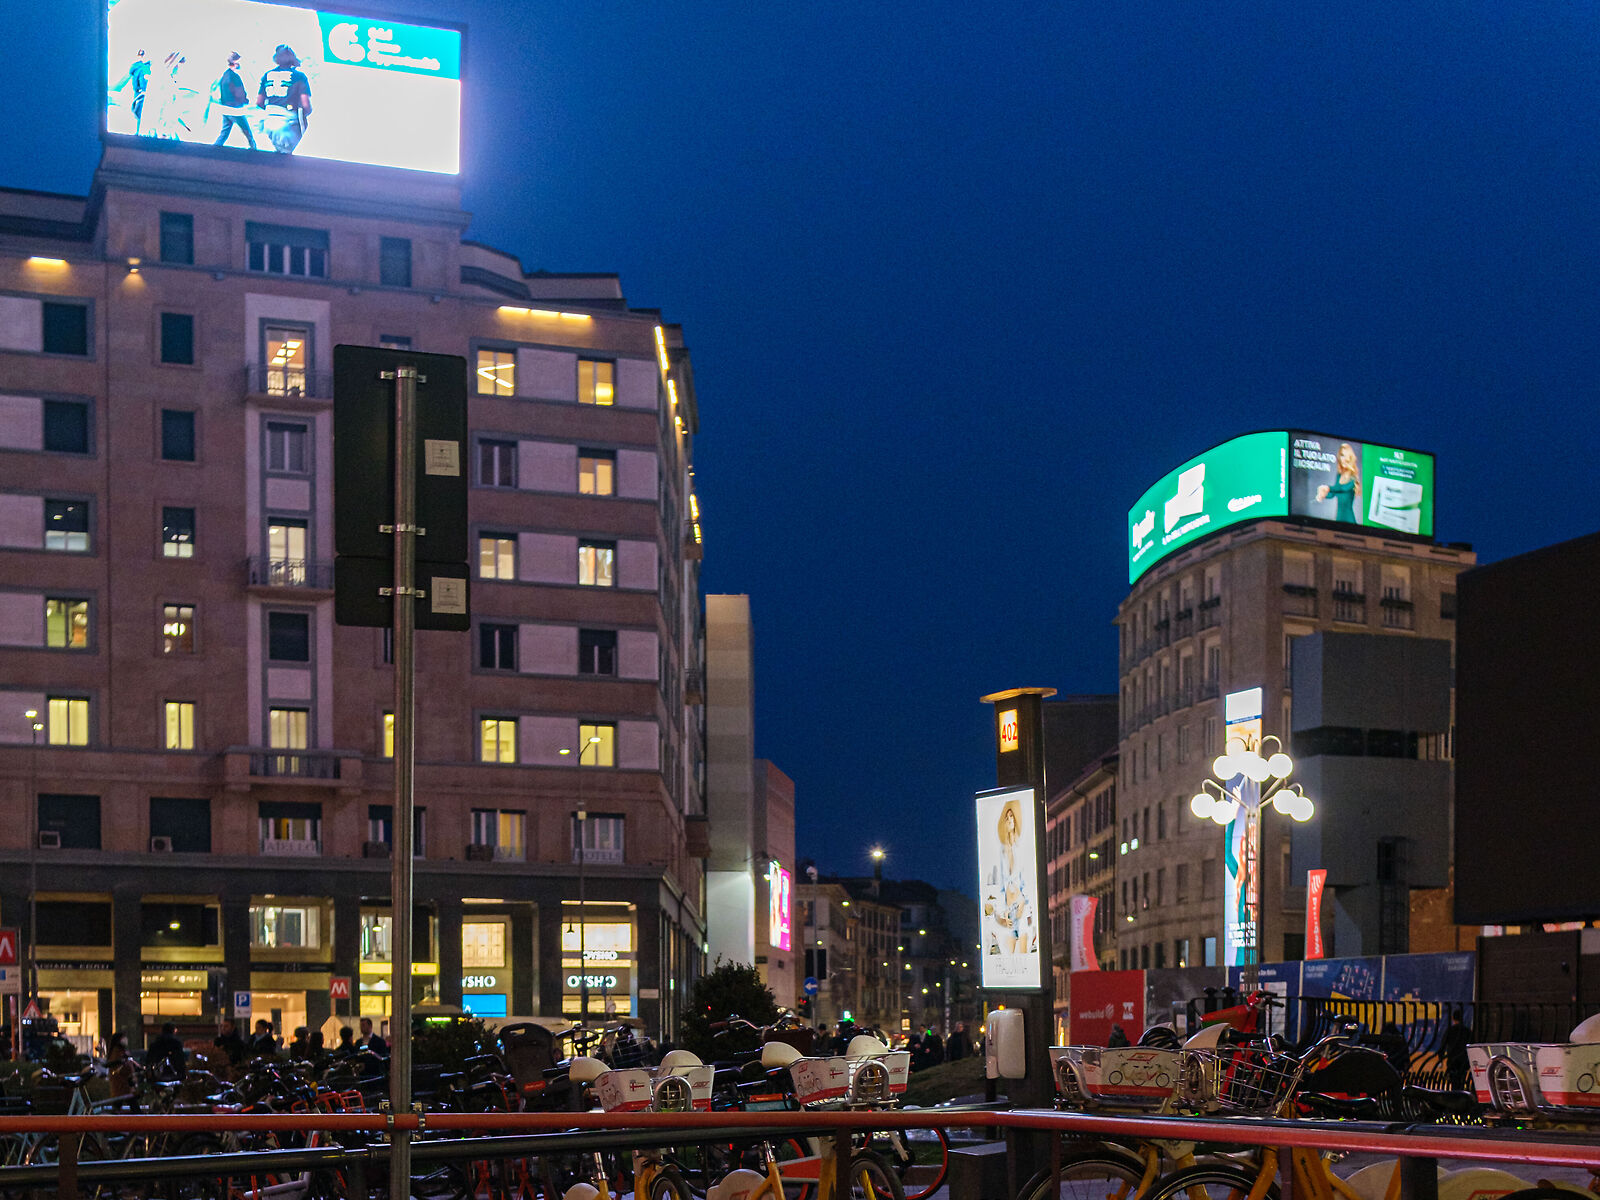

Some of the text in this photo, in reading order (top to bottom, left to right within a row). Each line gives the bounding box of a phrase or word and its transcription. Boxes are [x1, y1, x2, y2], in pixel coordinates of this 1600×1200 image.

[1294, 439, 1321, 450] ATTIVA
[1002, 722, 1018, 742] 402
[331, 982, 348, 995] M
